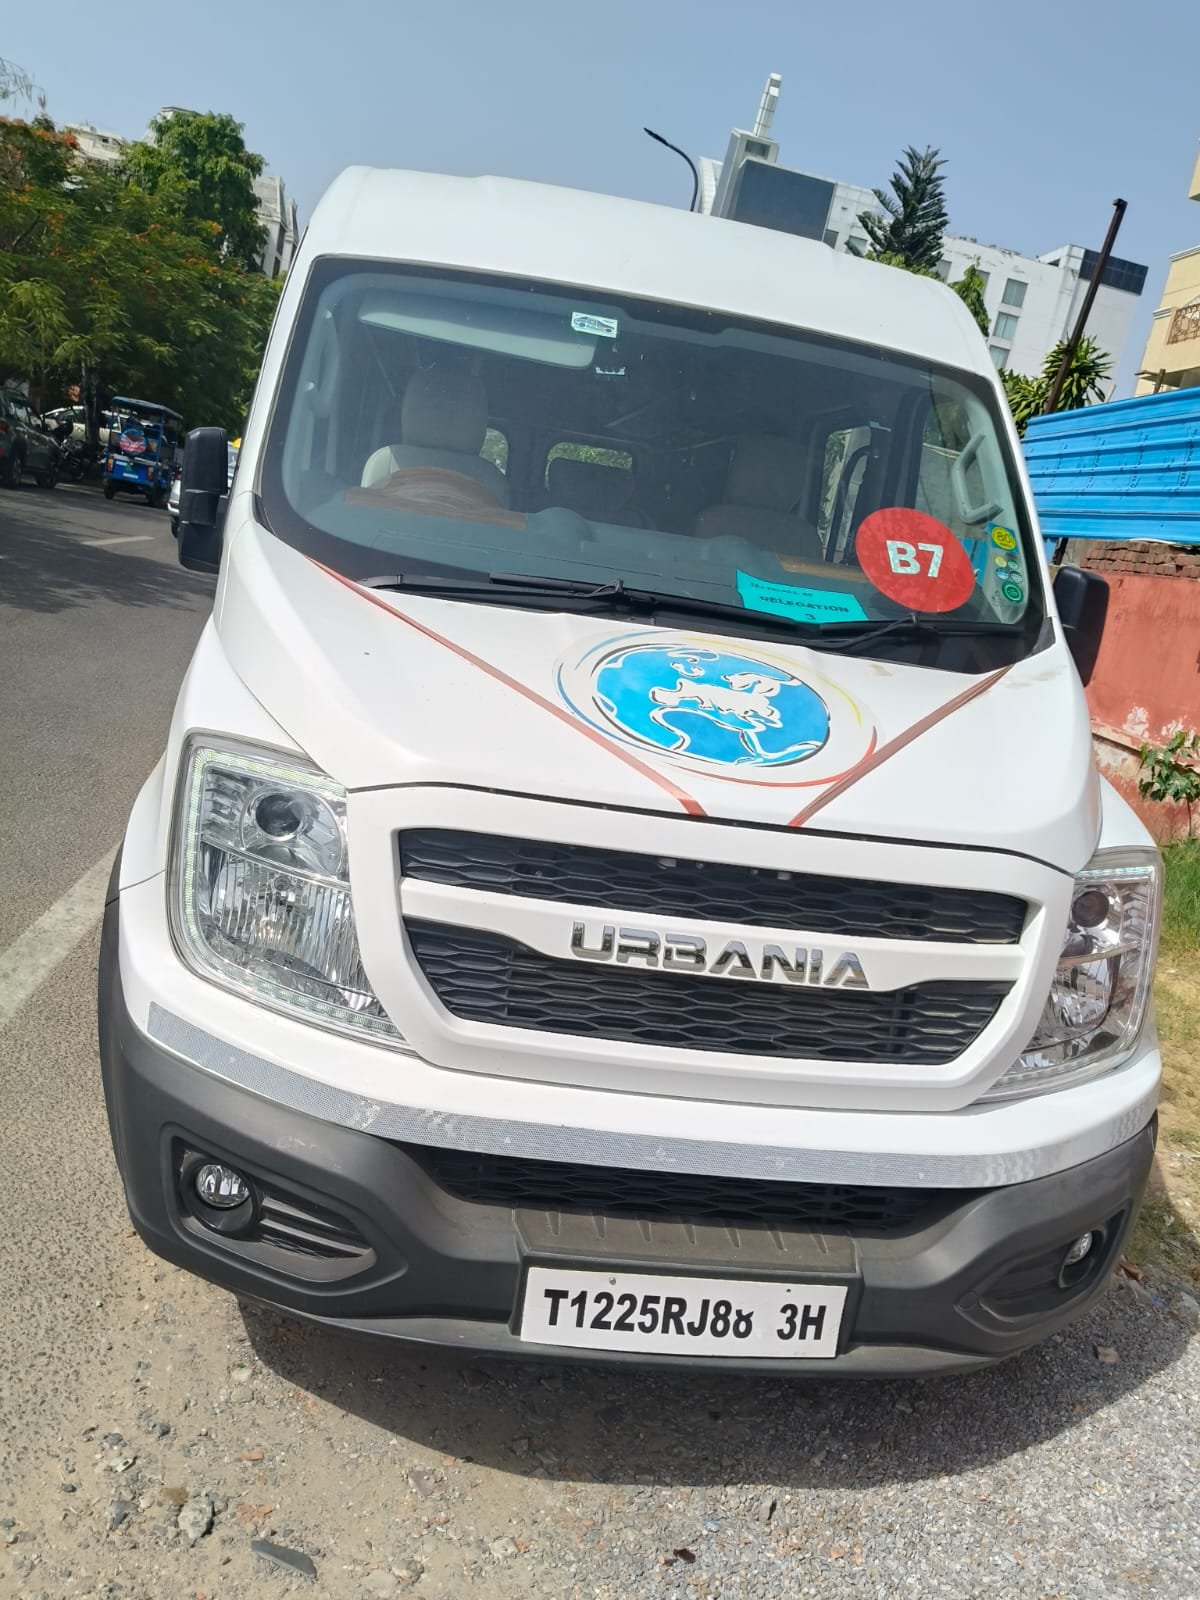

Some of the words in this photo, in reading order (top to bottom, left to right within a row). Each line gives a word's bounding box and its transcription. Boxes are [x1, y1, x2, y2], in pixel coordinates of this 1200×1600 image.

[886, 540, 944, 578] B7
[760, 595, 849, 613] DELEGATION
[571, 921, 870, 989] URBANIA
[776, 1303, 827, 1341] 3H
